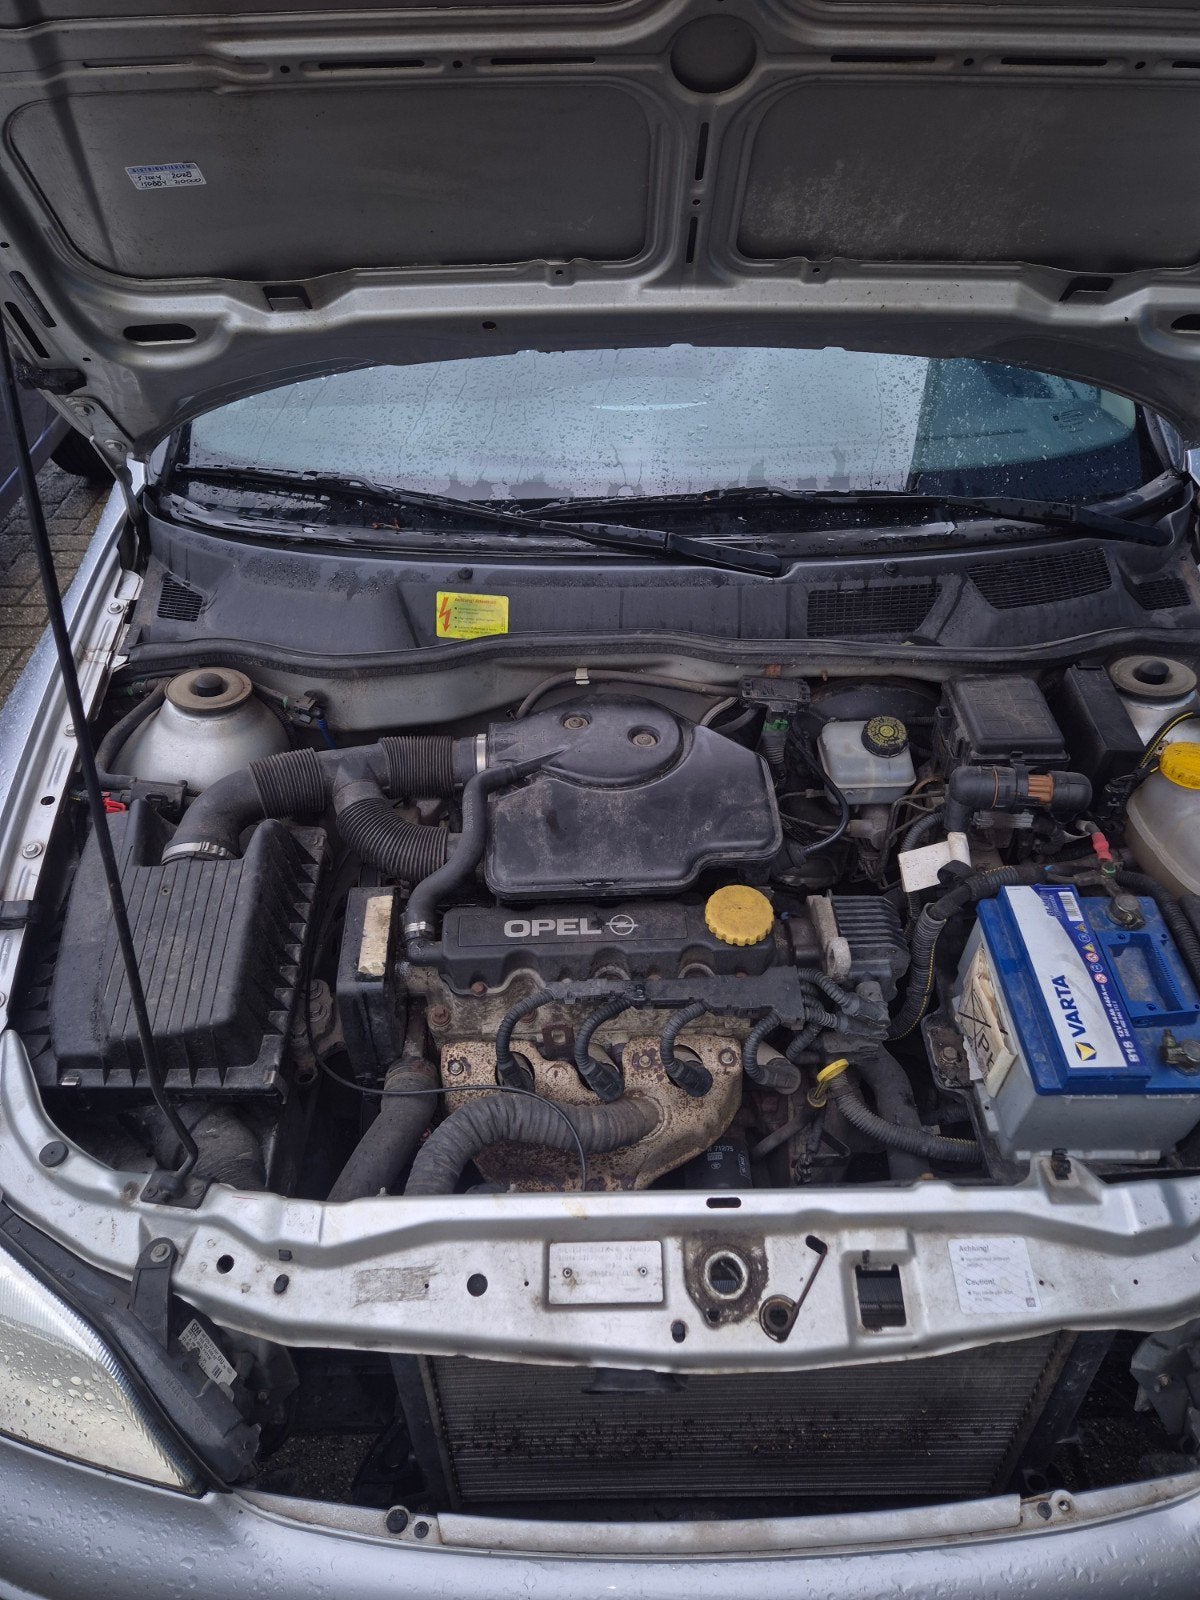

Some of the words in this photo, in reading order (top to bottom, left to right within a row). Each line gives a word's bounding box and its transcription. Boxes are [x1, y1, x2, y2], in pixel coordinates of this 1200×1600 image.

[503, 917, 602, 938] OPEL
[1051, 974, 1086, 1038] VARTA
[1115, 1025, 1124, 1037] 12V
[1122, 1041, 1140, 1062] B18
[959, 1245, 989, 1253] Achtung!
[965, 1278, 995, 1286] Caution!
[191, 1323, 202, 1335] GM
